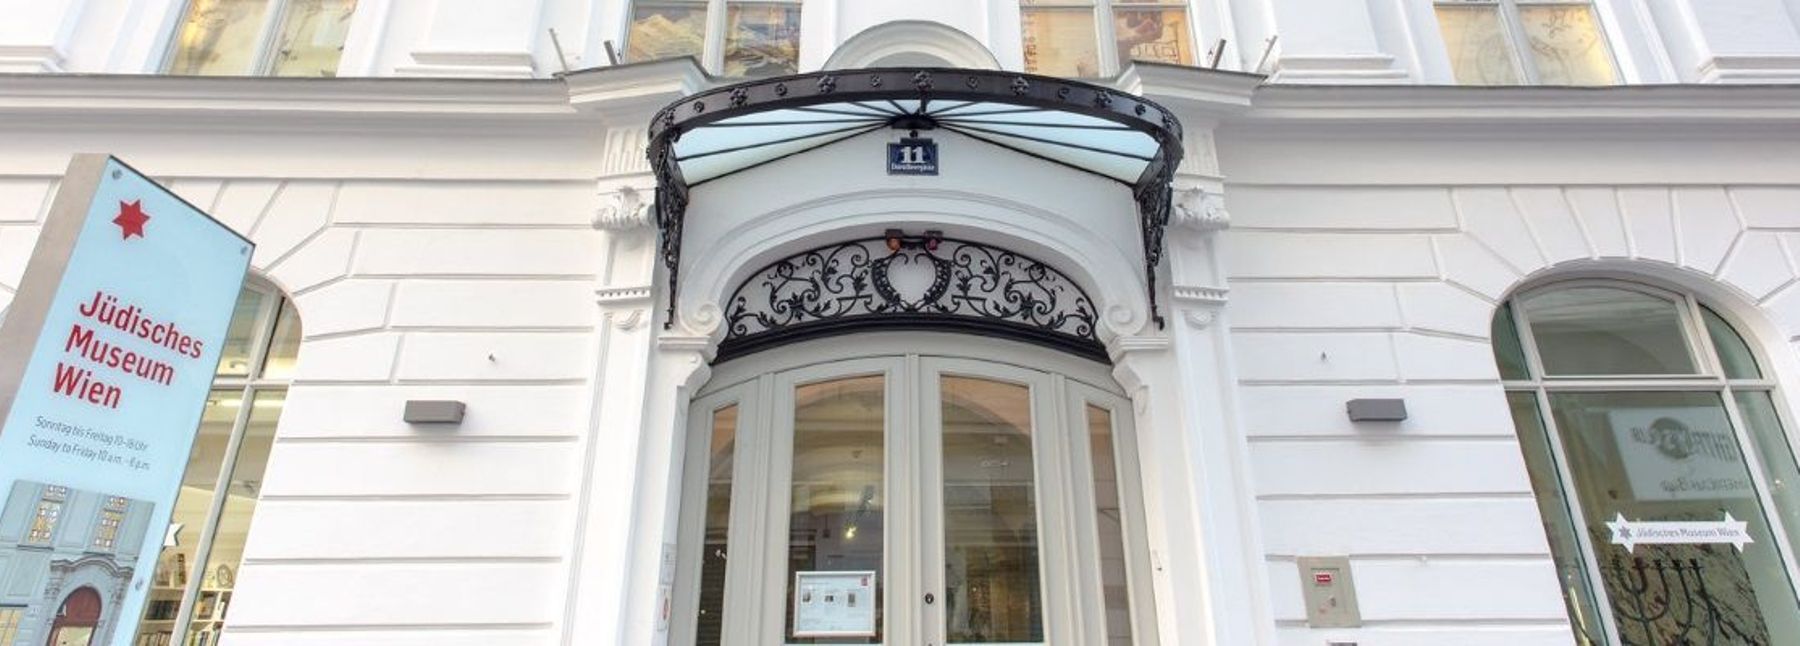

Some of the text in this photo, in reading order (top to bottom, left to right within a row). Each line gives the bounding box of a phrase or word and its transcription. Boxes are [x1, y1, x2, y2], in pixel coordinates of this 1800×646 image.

[900, 146, 926, 163] 11
[79, 291, 203, 359] Jüdisches
[64, 323, 174, 386] Museum
[52, 361, 122, 410] Wien
[28, 434, 61, 453] Sunday
[62, 442, 71, 452] to
[71, 443, 98, 462] Friday
[97, 449, 109, 462] 10
[35, 415, 72, 436] Sonntag
[72, 425, 85, 438] bis
[86, 427, 114, 446] Freitag
